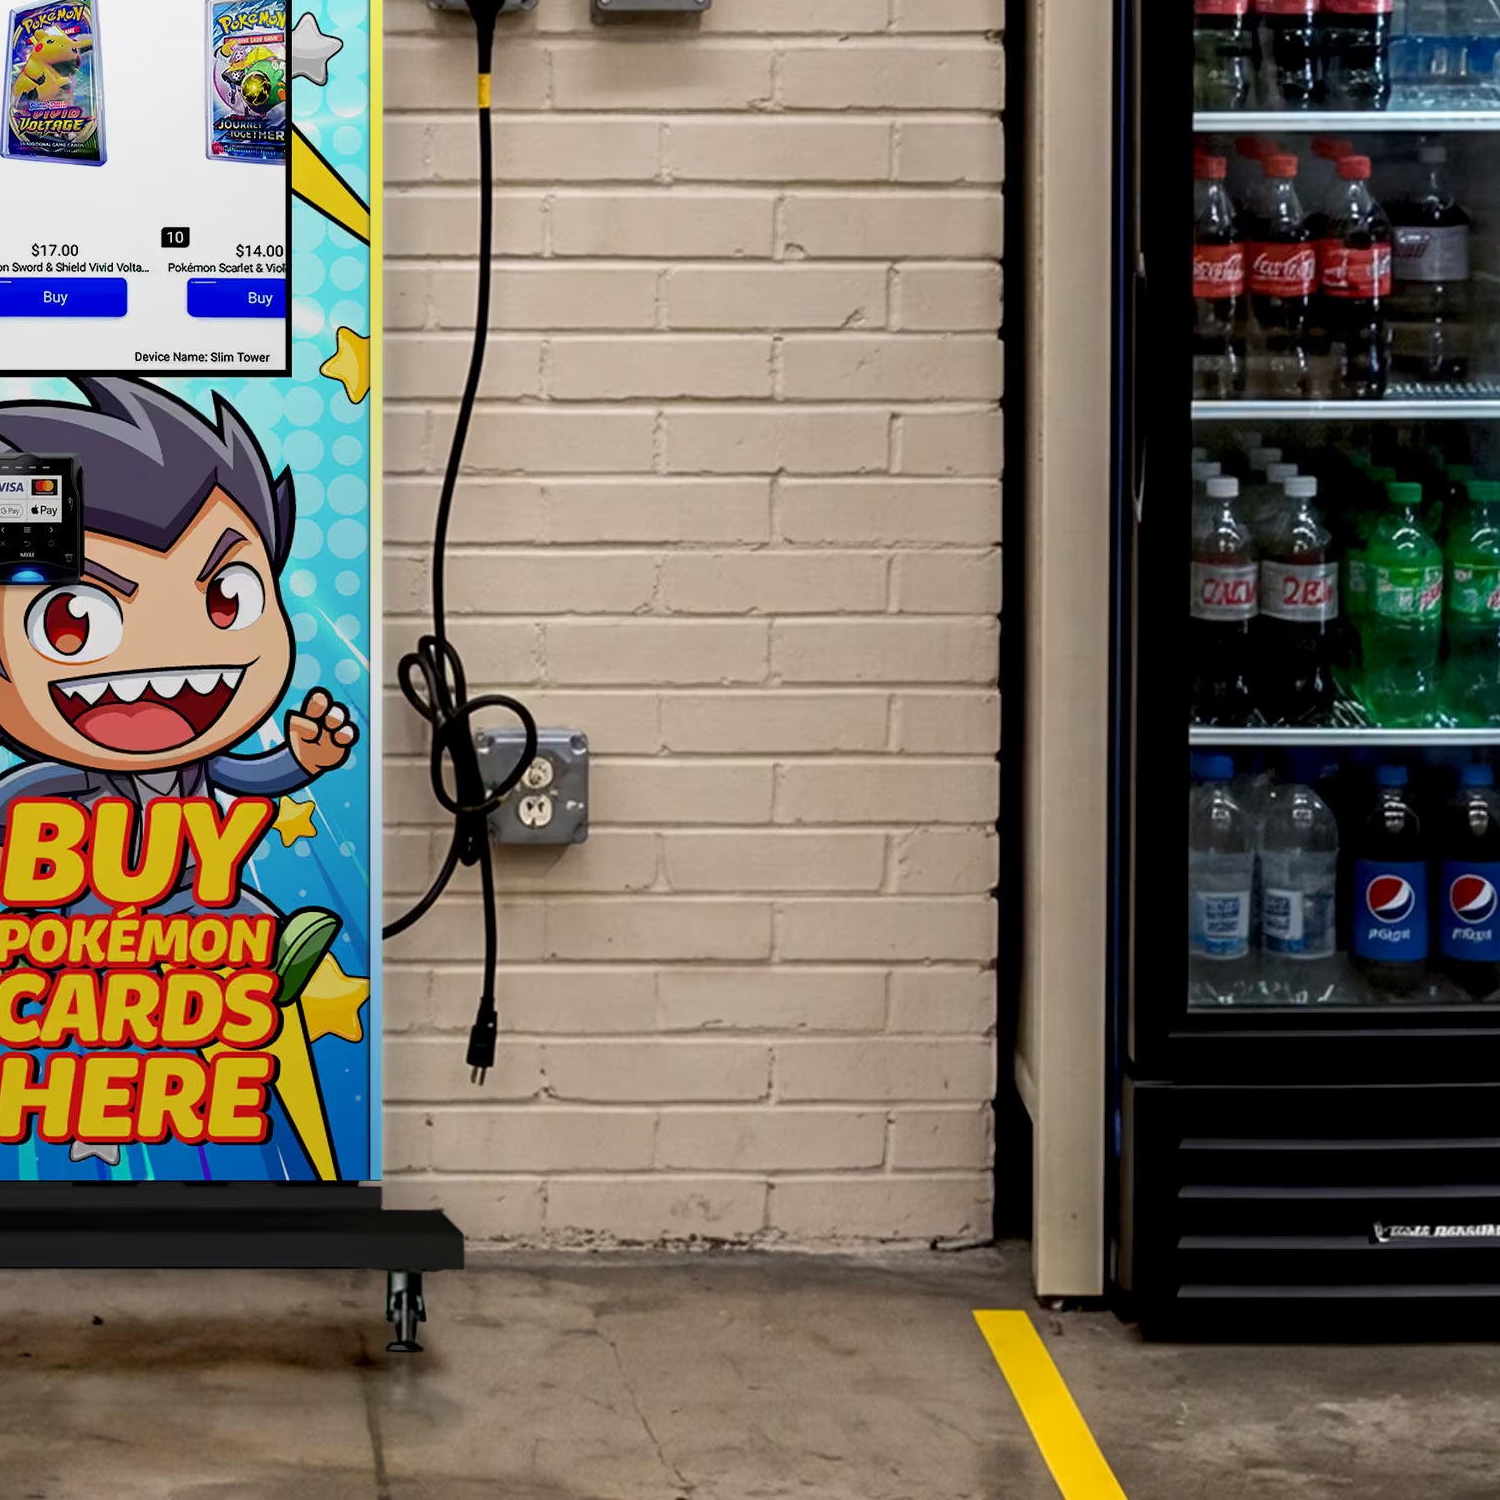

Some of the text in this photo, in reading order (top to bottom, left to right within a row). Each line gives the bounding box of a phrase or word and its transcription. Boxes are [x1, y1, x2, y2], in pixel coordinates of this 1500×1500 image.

[18, 116, 85, 134] VOLTAGE
[166, 231, 184, 244] 10
[31, 243, 79, 258] $17.00
[235, 243, 284, 258] $14.00
[11, 262, 43, 273] Sword
[45, 262, 54, 273] &
[55, 262, 87, 273] Shield
[89, 262, 114, 273] Vivid
[116, 262, 150, 273] Volta...
[167, 262, 217, 273] Pokémon
[218, 262, 254, 273] Scarlet
[255, 263, 264, 273] &
[43, 290, 68, 306] Buy
[247, 291, 273, 307] Buy
[134, 351, 270, 363] Device Name: Slim Tower
[8, 507, 20, 517] Pay
[40, 505, 58, 517] Pay
